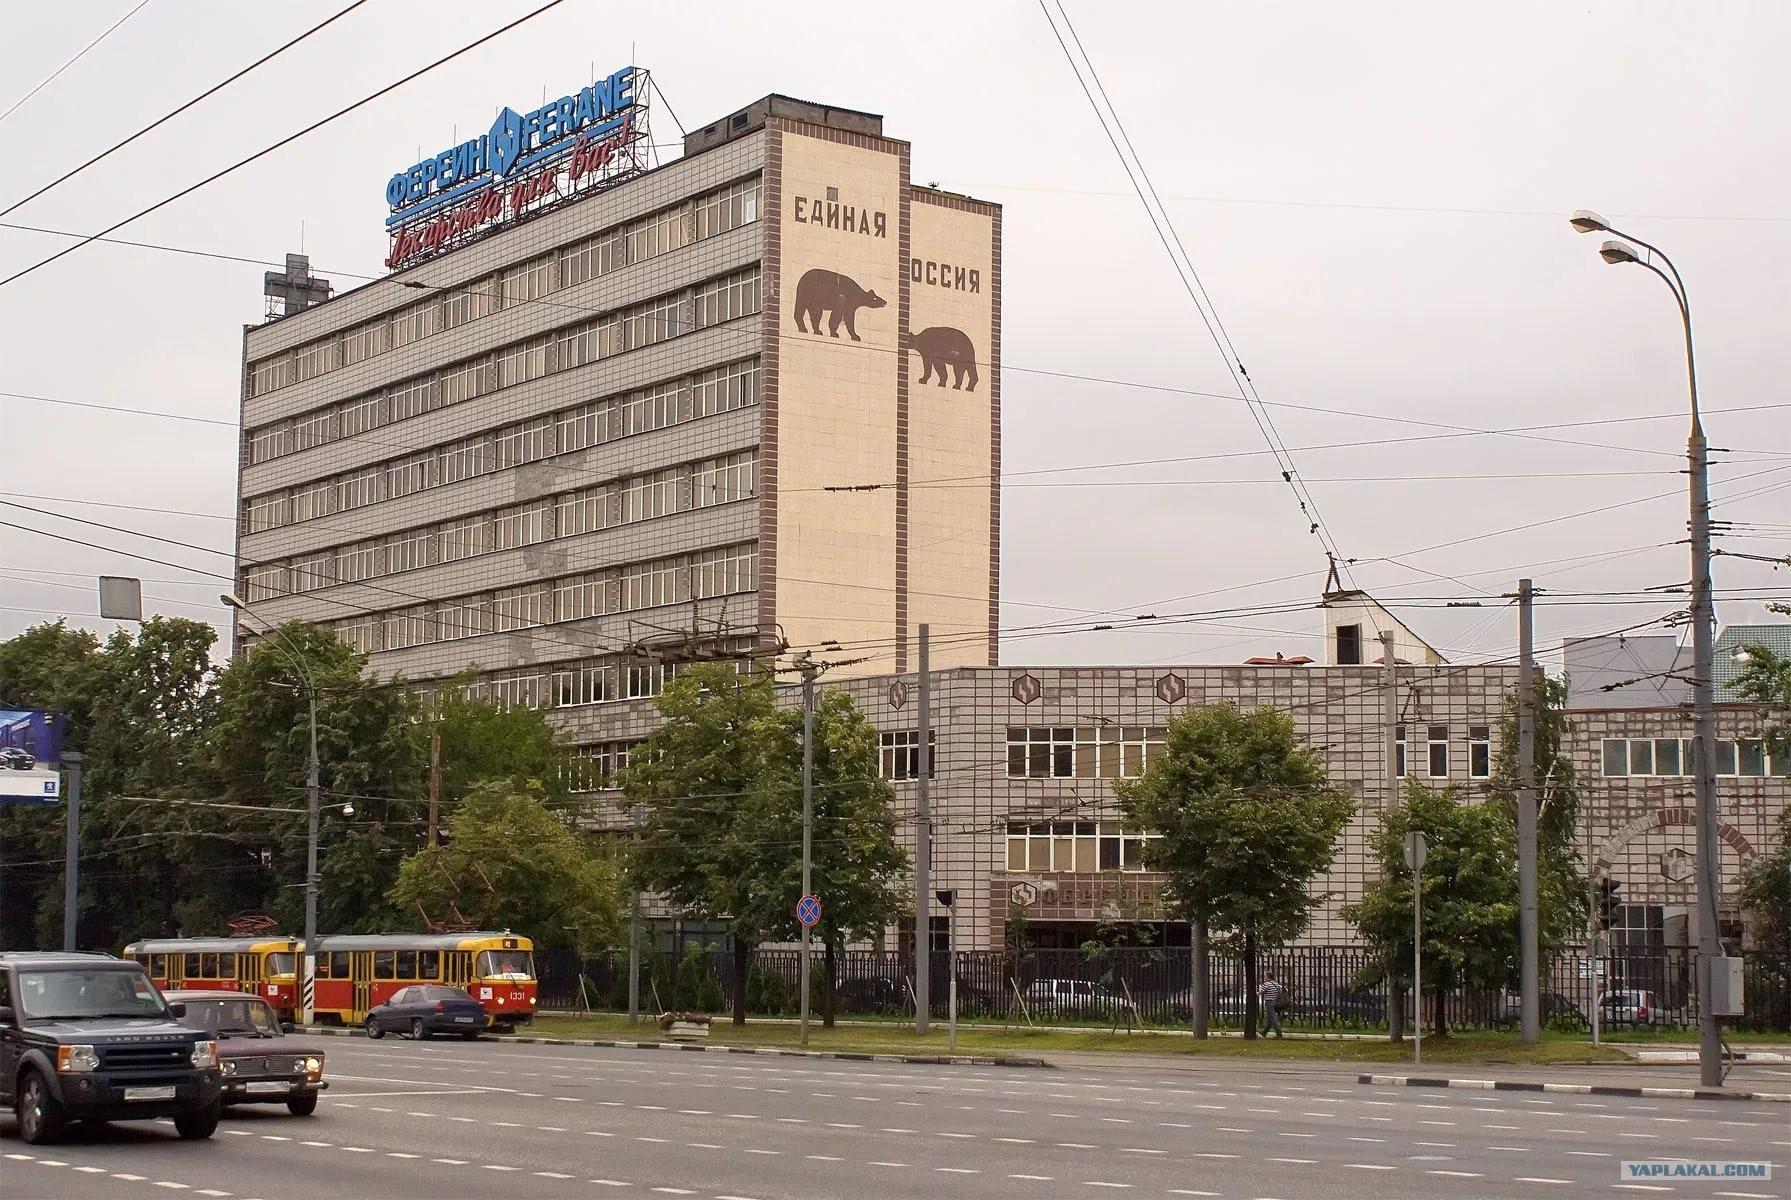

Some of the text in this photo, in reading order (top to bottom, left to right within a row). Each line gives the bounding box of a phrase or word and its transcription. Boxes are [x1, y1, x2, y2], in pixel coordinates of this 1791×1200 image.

[524, 66, 635, 151] FERANE
[794, 195, 887, 239] ЕДИНАЯ
[911, 257, 980, 294] ОССИЯ
[510, 992, 525, 1000] 1331
